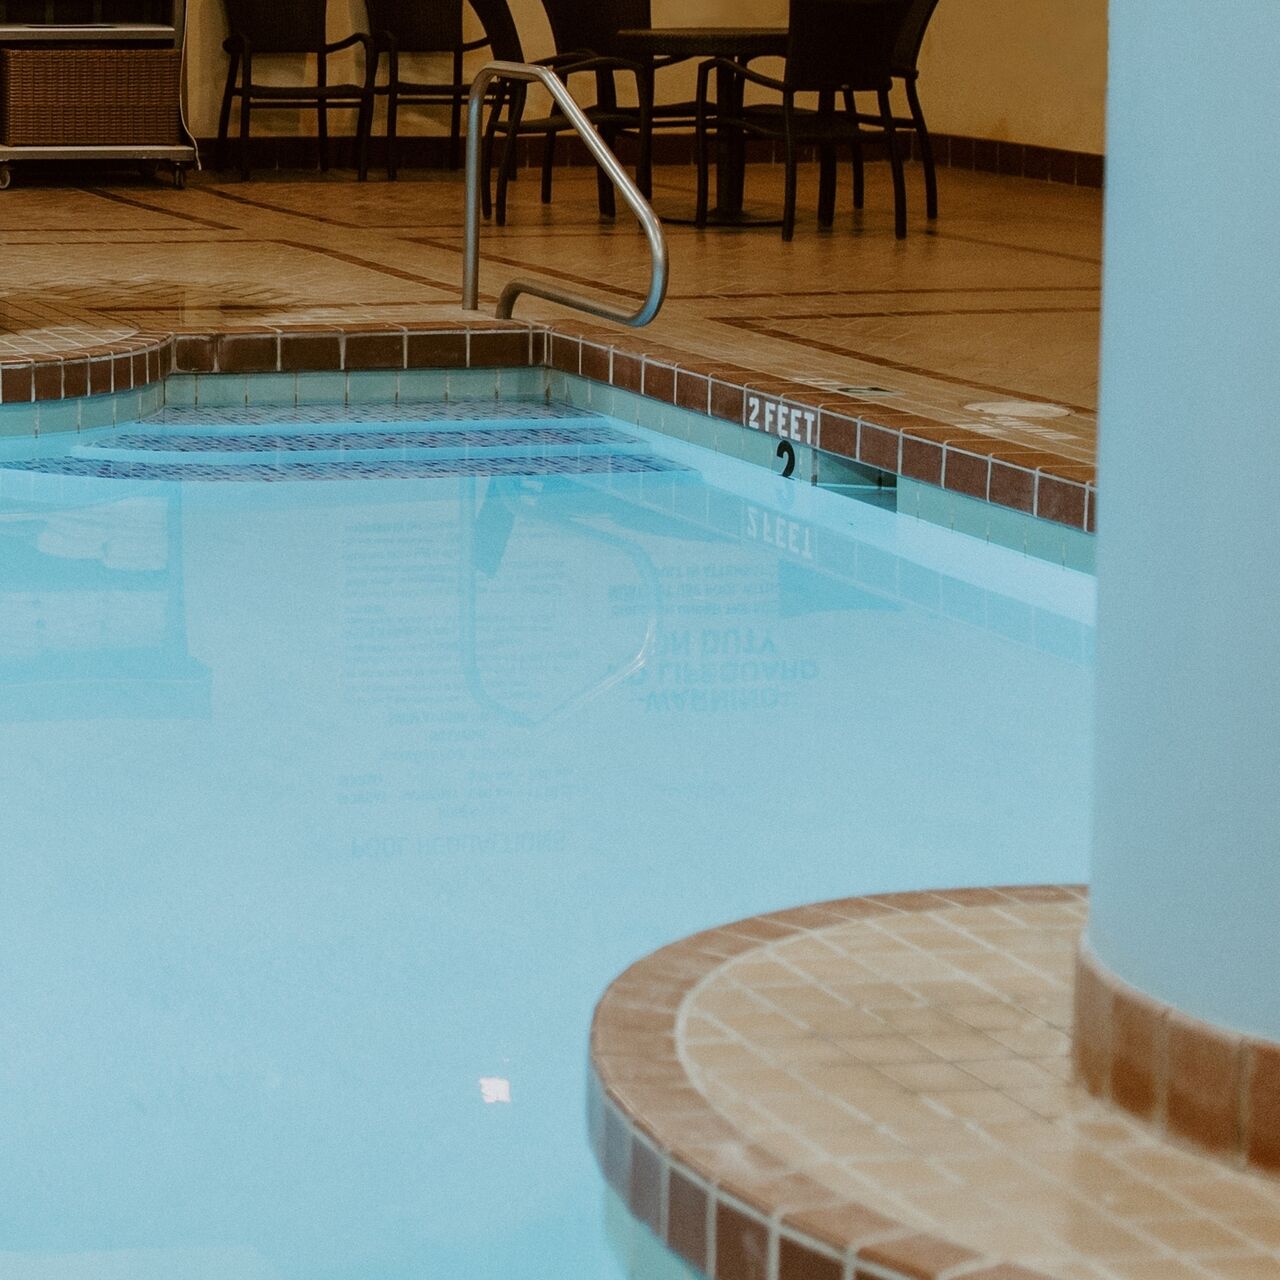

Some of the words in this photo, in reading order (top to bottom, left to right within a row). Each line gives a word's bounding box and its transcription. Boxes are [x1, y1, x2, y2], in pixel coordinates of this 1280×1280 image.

[748, 397, 760, 430] 2
[764, 403, 815, 445] FEET
[776, 440, 796, 481] 2
